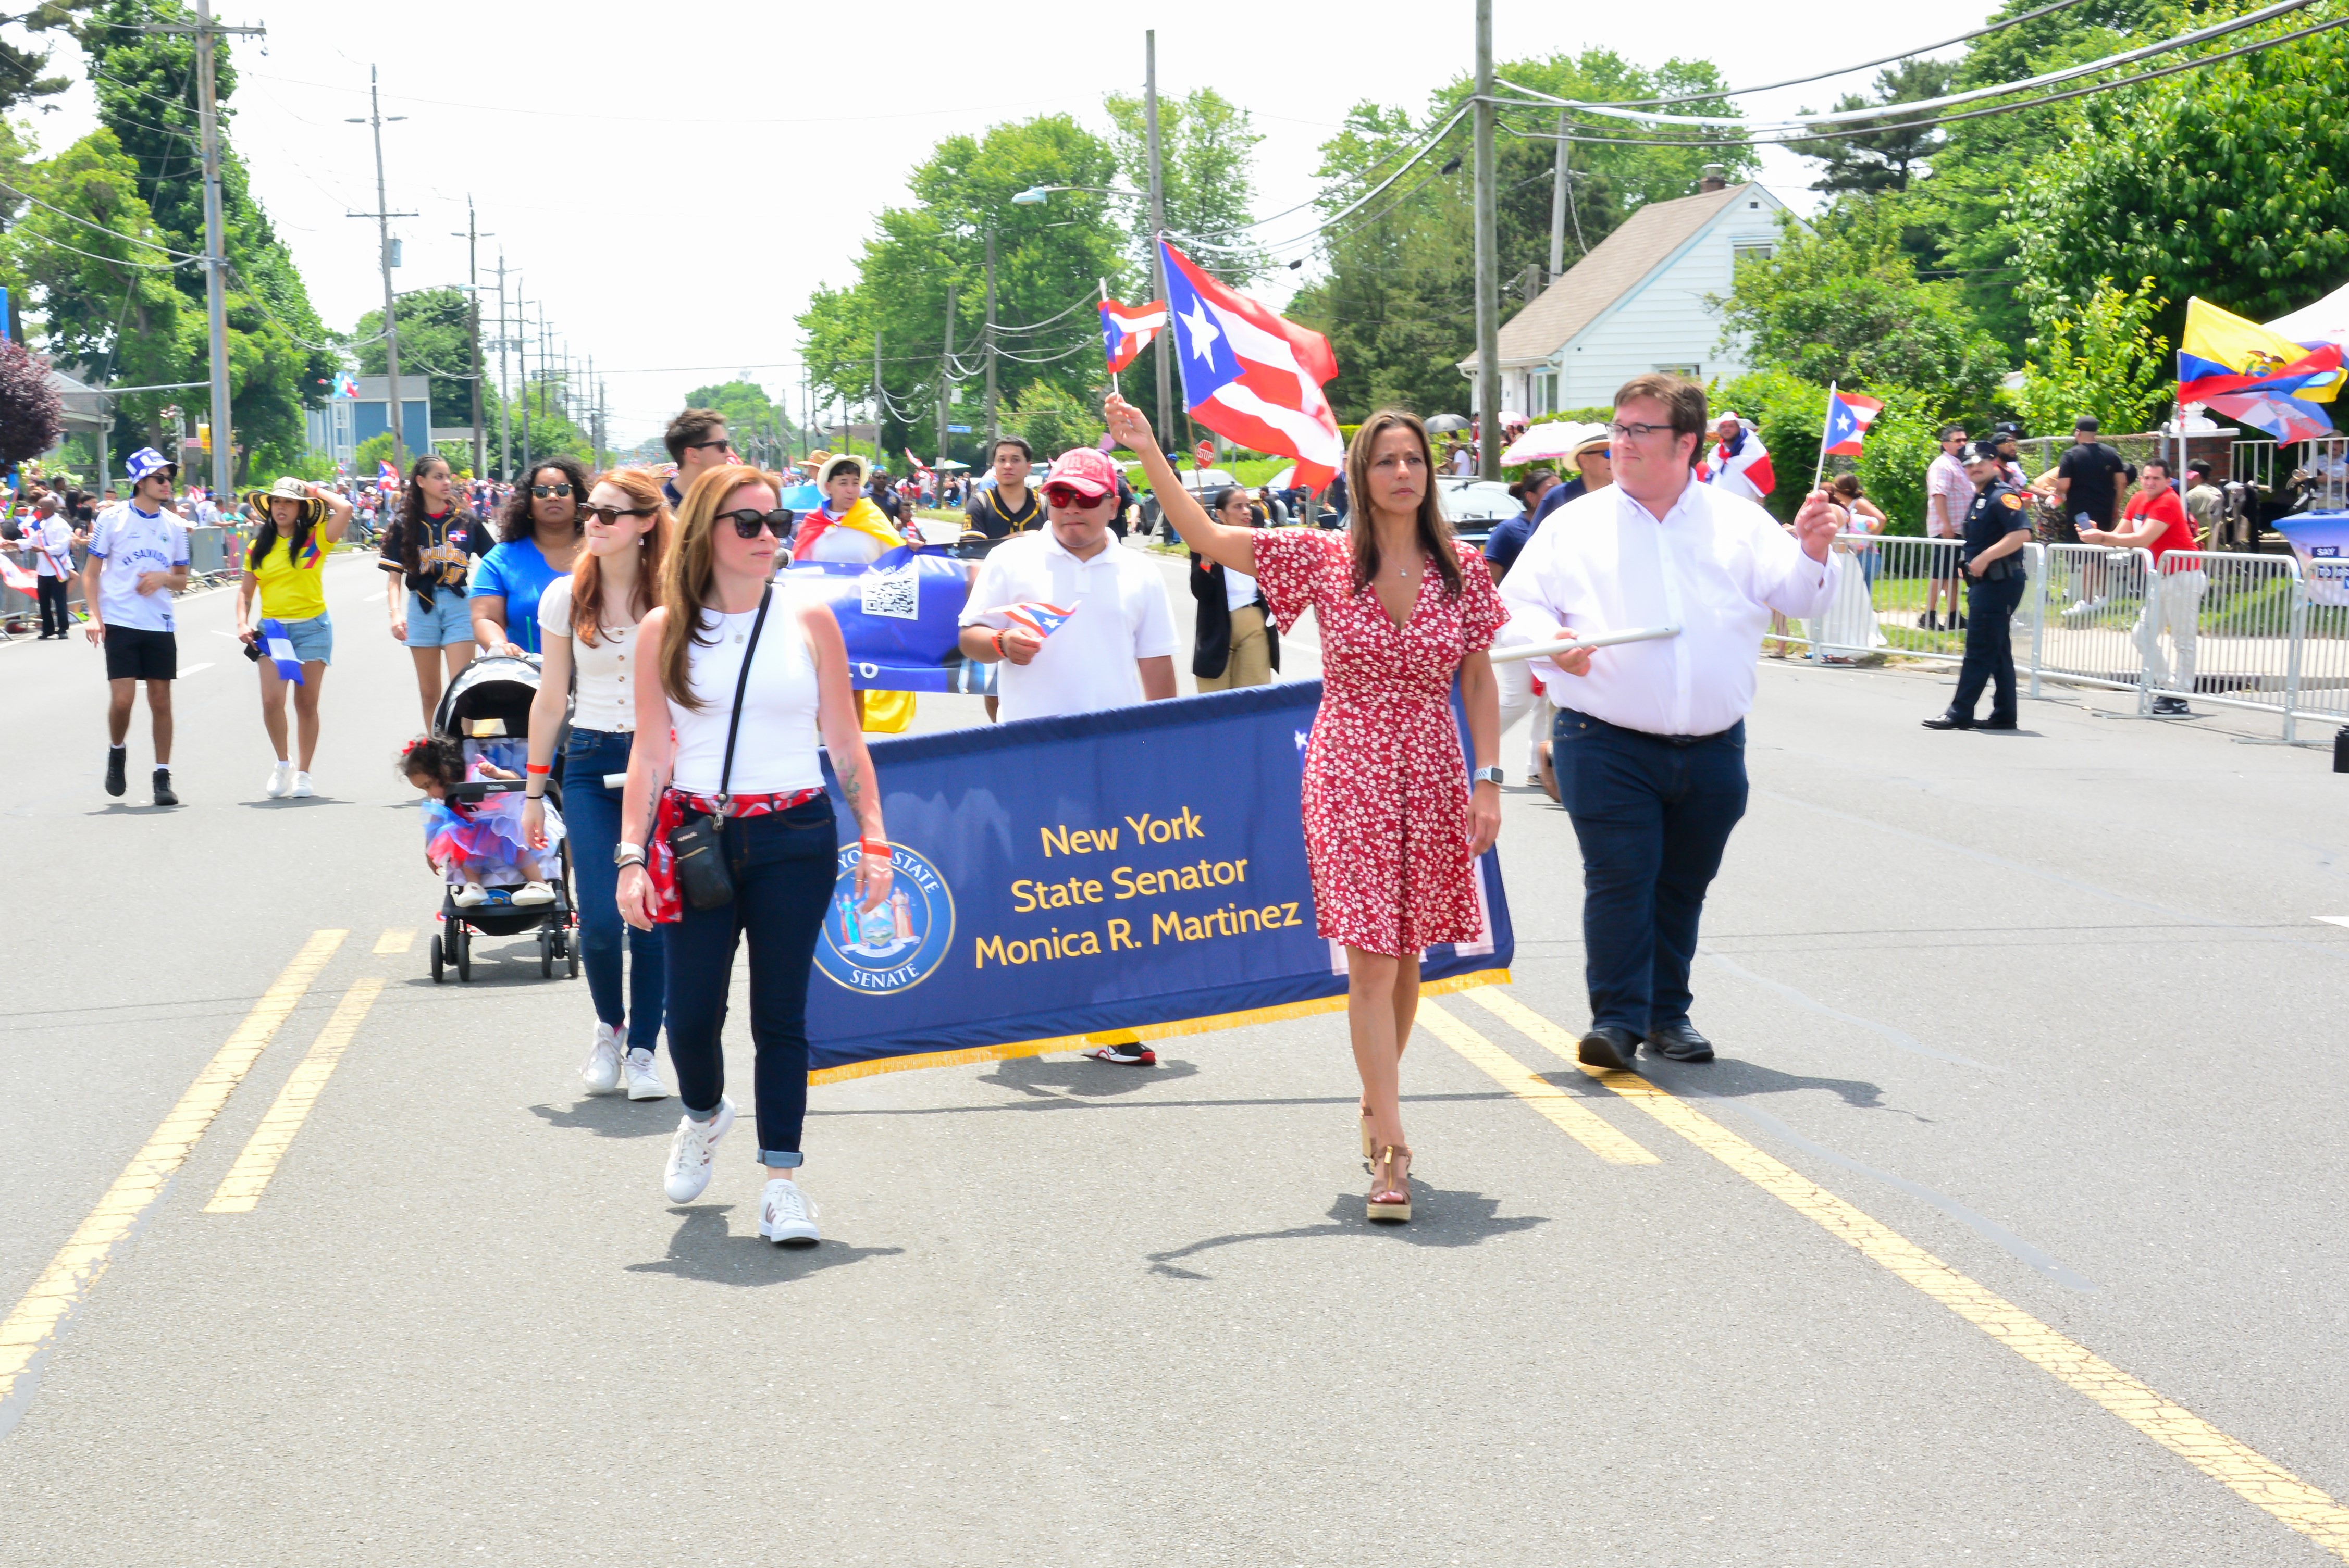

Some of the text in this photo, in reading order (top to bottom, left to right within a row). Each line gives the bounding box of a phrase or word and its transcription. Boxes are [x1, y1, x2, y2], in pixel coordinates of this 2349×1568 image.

[1197, 447, 1214, 462] STOP
[2317, 547, 2335, 556] SAY
[1041, 806, 1205, 857] New York
[892, 851, 939, 893] STATE
[1011, 858, 1248, 913] State Senator
[976, 902, 1303, 969] Monica R. Martinez
[850, 963, 920, 988] SENATE
